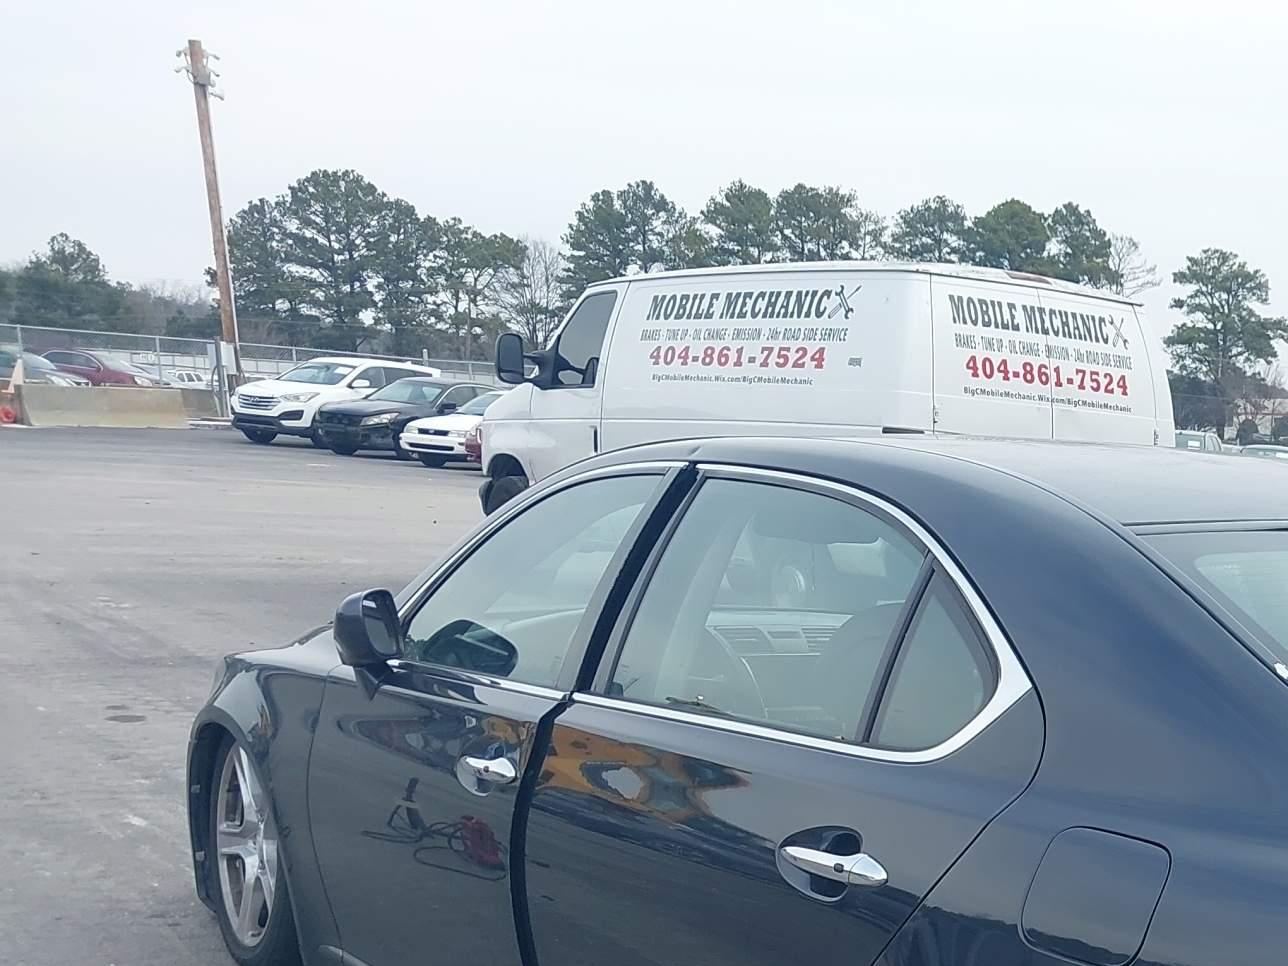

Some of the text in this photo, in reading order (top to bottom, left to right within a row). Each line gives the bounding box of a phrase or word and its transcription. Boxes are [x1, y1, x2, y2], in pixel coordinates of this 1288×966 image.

[646, 289, 832, 320] MOBILE MECHANIC
[948, 294, 1109, 345] MOBILE MECHANIC
[640, 326, 848, 342] BRAKES TUNE UP OIL CHANGE EMISSION 24hr ROAD SIDE SERVICE
[649, 345, 826, 369] 404-861-7524
[954, 332, 977, 350] BRAKES
[980, 335, 995, 352] TUNE
[995, 338, 1004, 353] UP
[1008, 339, 1018, 355] OIL
[1018, 340, 1041, 357] CHANGE
[1085, 350, 1100, 366] ROAD
[1100, 352, 1112, 367] SIDE
[1112, 354, 1132, 370] SERVICE
[966, 355, 1129, 396] 404-861-7524
[963, 386, 1132, 413] BigCMobileMechanic.Wixcom/BigCMobileMechanic
